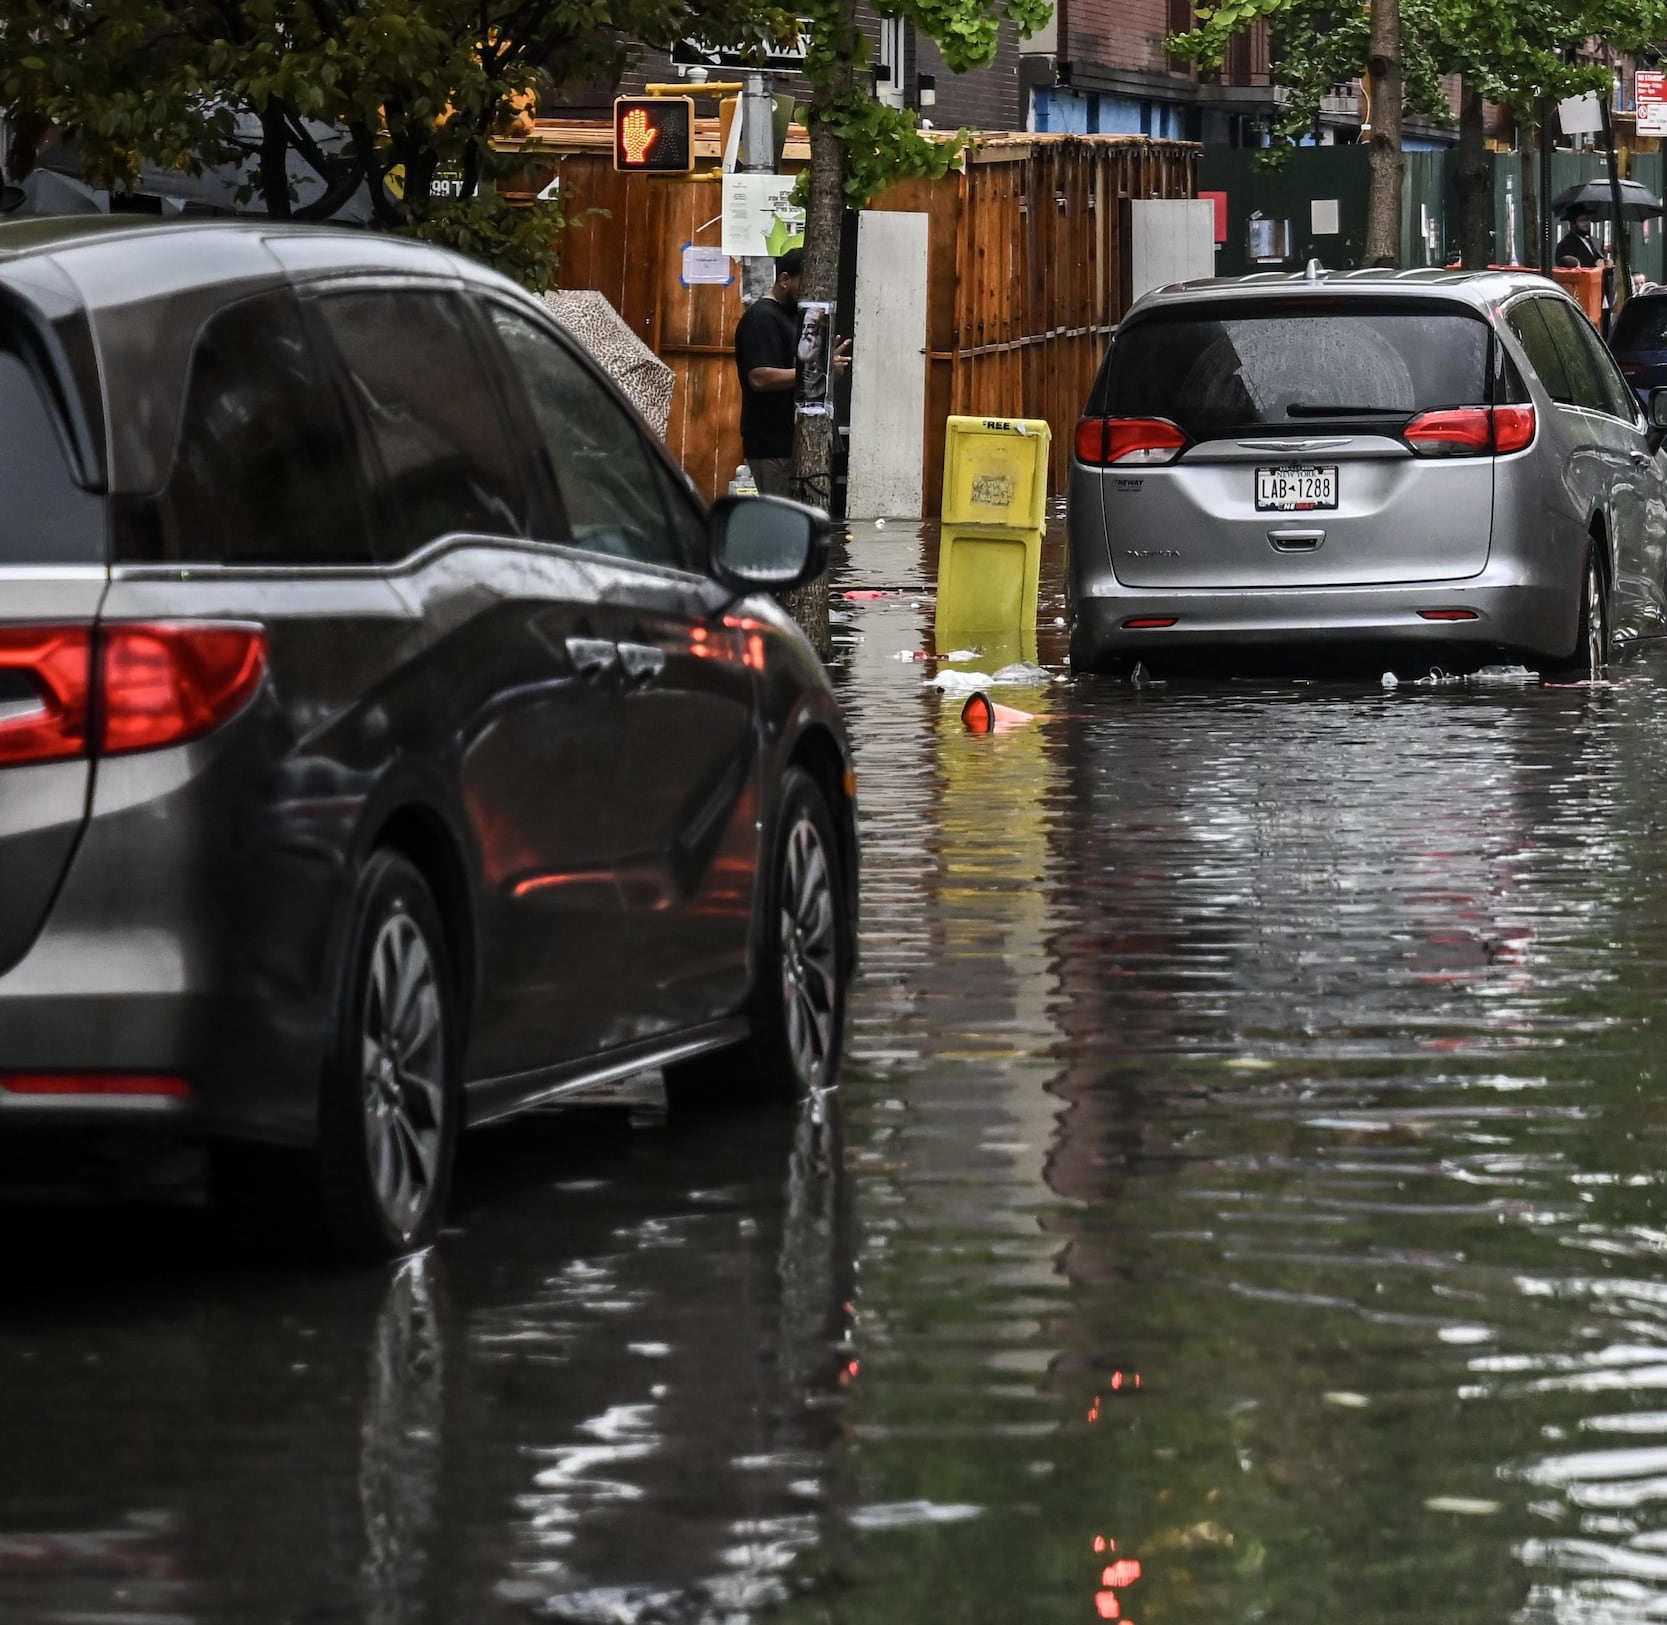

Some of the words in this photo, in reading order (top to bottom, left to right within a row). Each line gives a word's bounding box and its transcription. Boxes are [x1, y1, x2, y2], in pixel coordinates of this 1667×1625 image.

[1276, 471, 1296, 479] NEW
[1296, 470, 1319, 478] YORK
[1262, 479, 1287, 499] LAB
[1298, 478, 1331, 498] 1288
